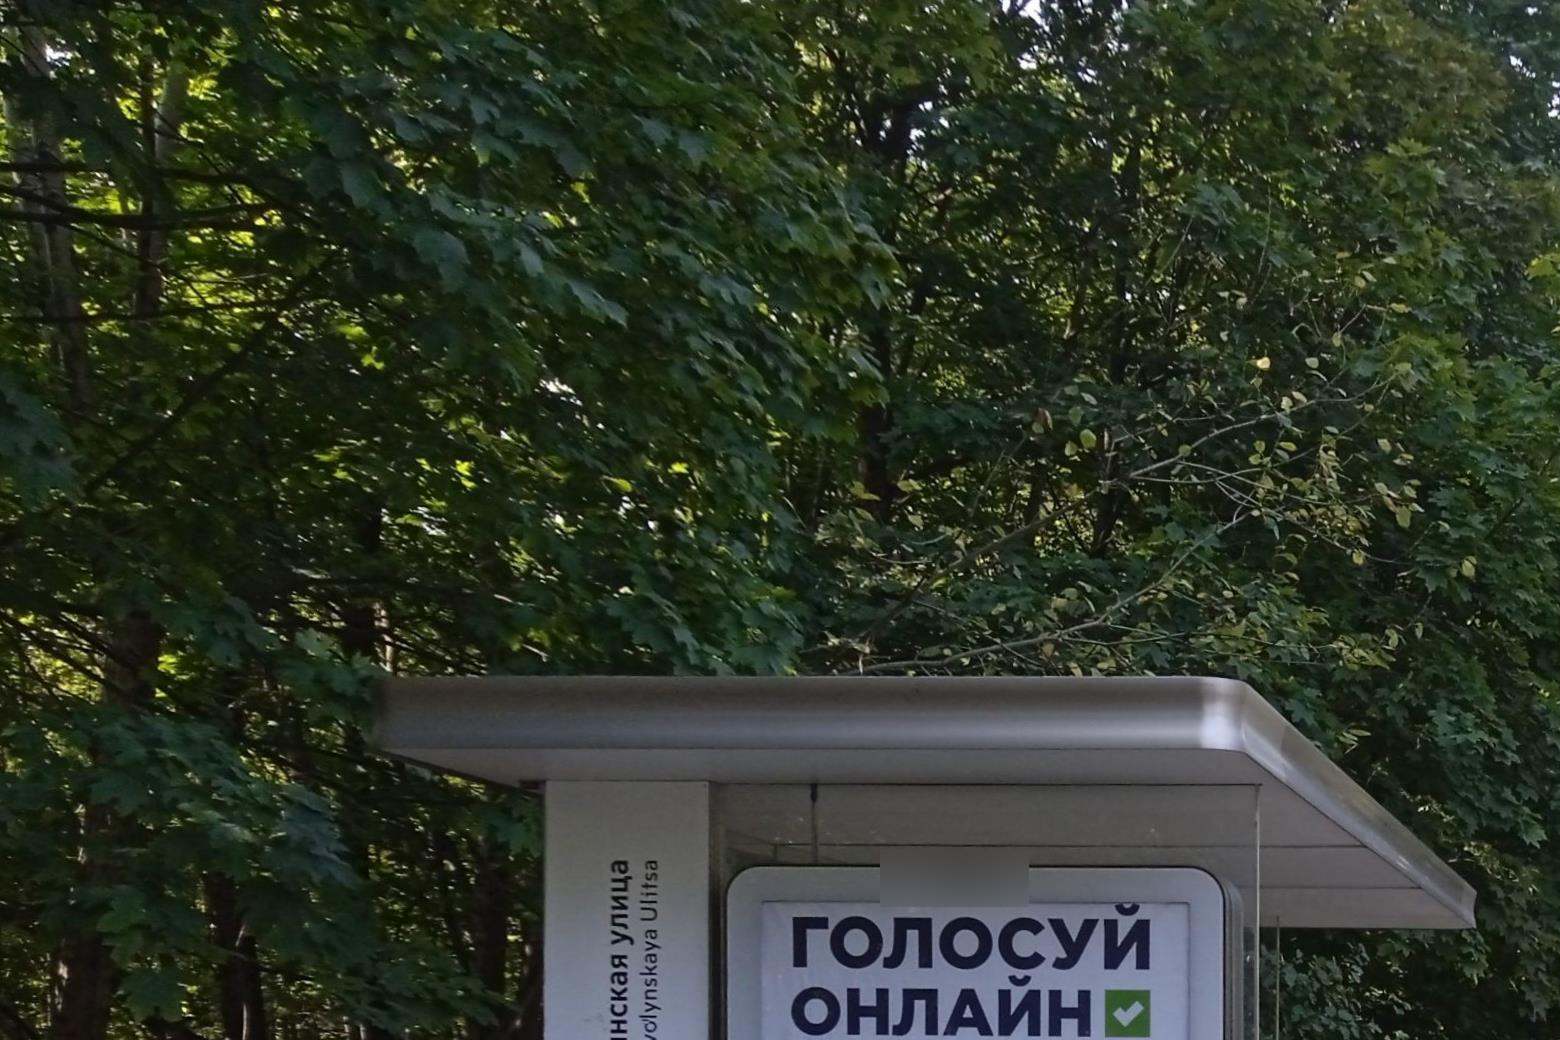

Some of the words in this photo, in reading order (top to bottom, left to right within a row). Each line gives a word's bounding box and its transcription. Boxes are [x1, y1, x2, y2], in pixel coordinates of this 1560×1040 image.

[611, 860, 635, 946] улица
[640, 860, 658, 921] Ulitsa
[792, 902, 1151, 971] ГОЛОСУЙ
[790, 975, 1092, 1038] ОНЛАЙН
